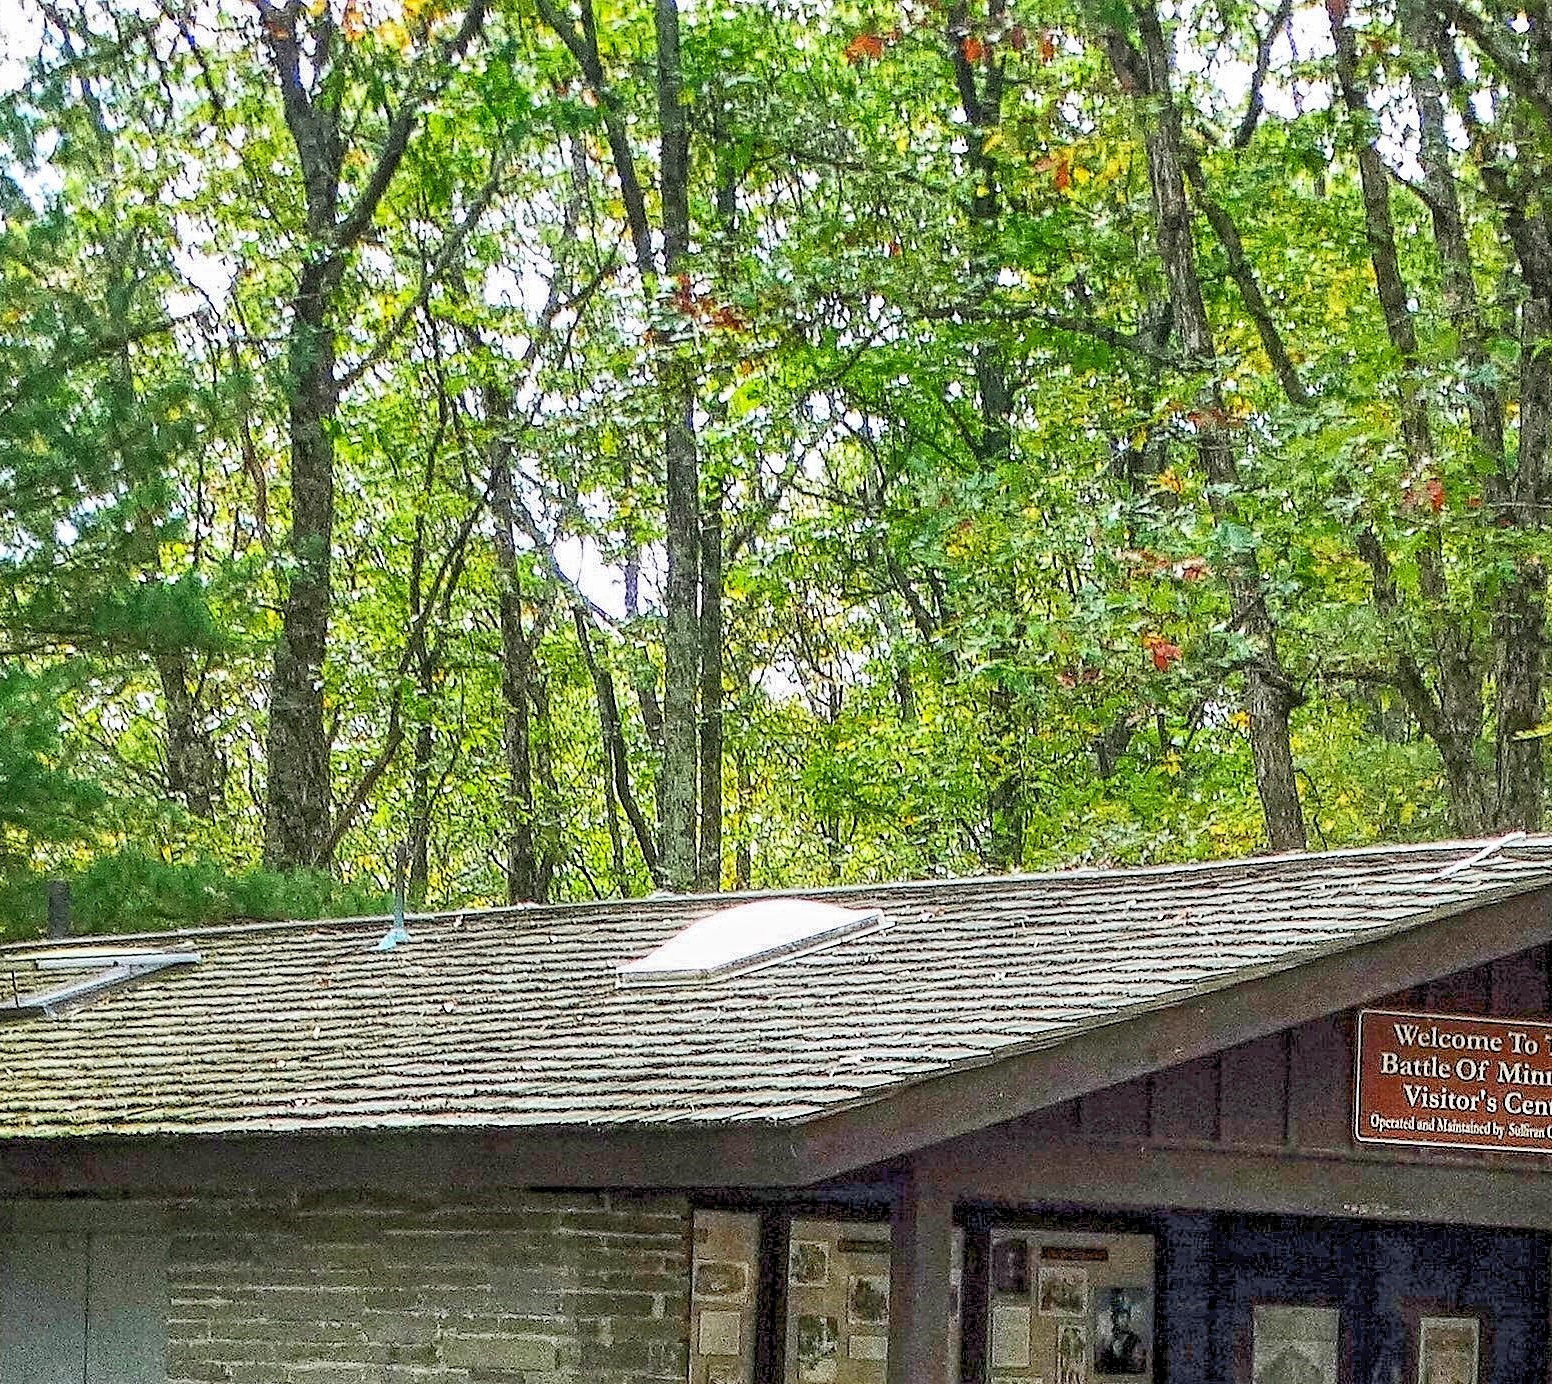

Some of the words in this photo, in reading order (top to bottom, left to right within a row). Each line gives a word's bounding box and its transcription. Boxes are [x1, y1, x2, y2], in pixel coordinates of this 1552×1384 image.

[1393, 1023, 1503, 1052] Welcome
[1508, 1031, 1538, 1055] To
[1380, 1051, 1450, 1078] Battle
[1455, 1058, 1490, 1081] Of
[1403, 1082, 1497, 1113] Visitor's
[1369, 1112, 1415, 1133] Operated
[1416, 1116, 1435, 1131] and
[1436, 1116, 1491, 1136] Maintained
[1492, 1121, 1504, 1140] by
